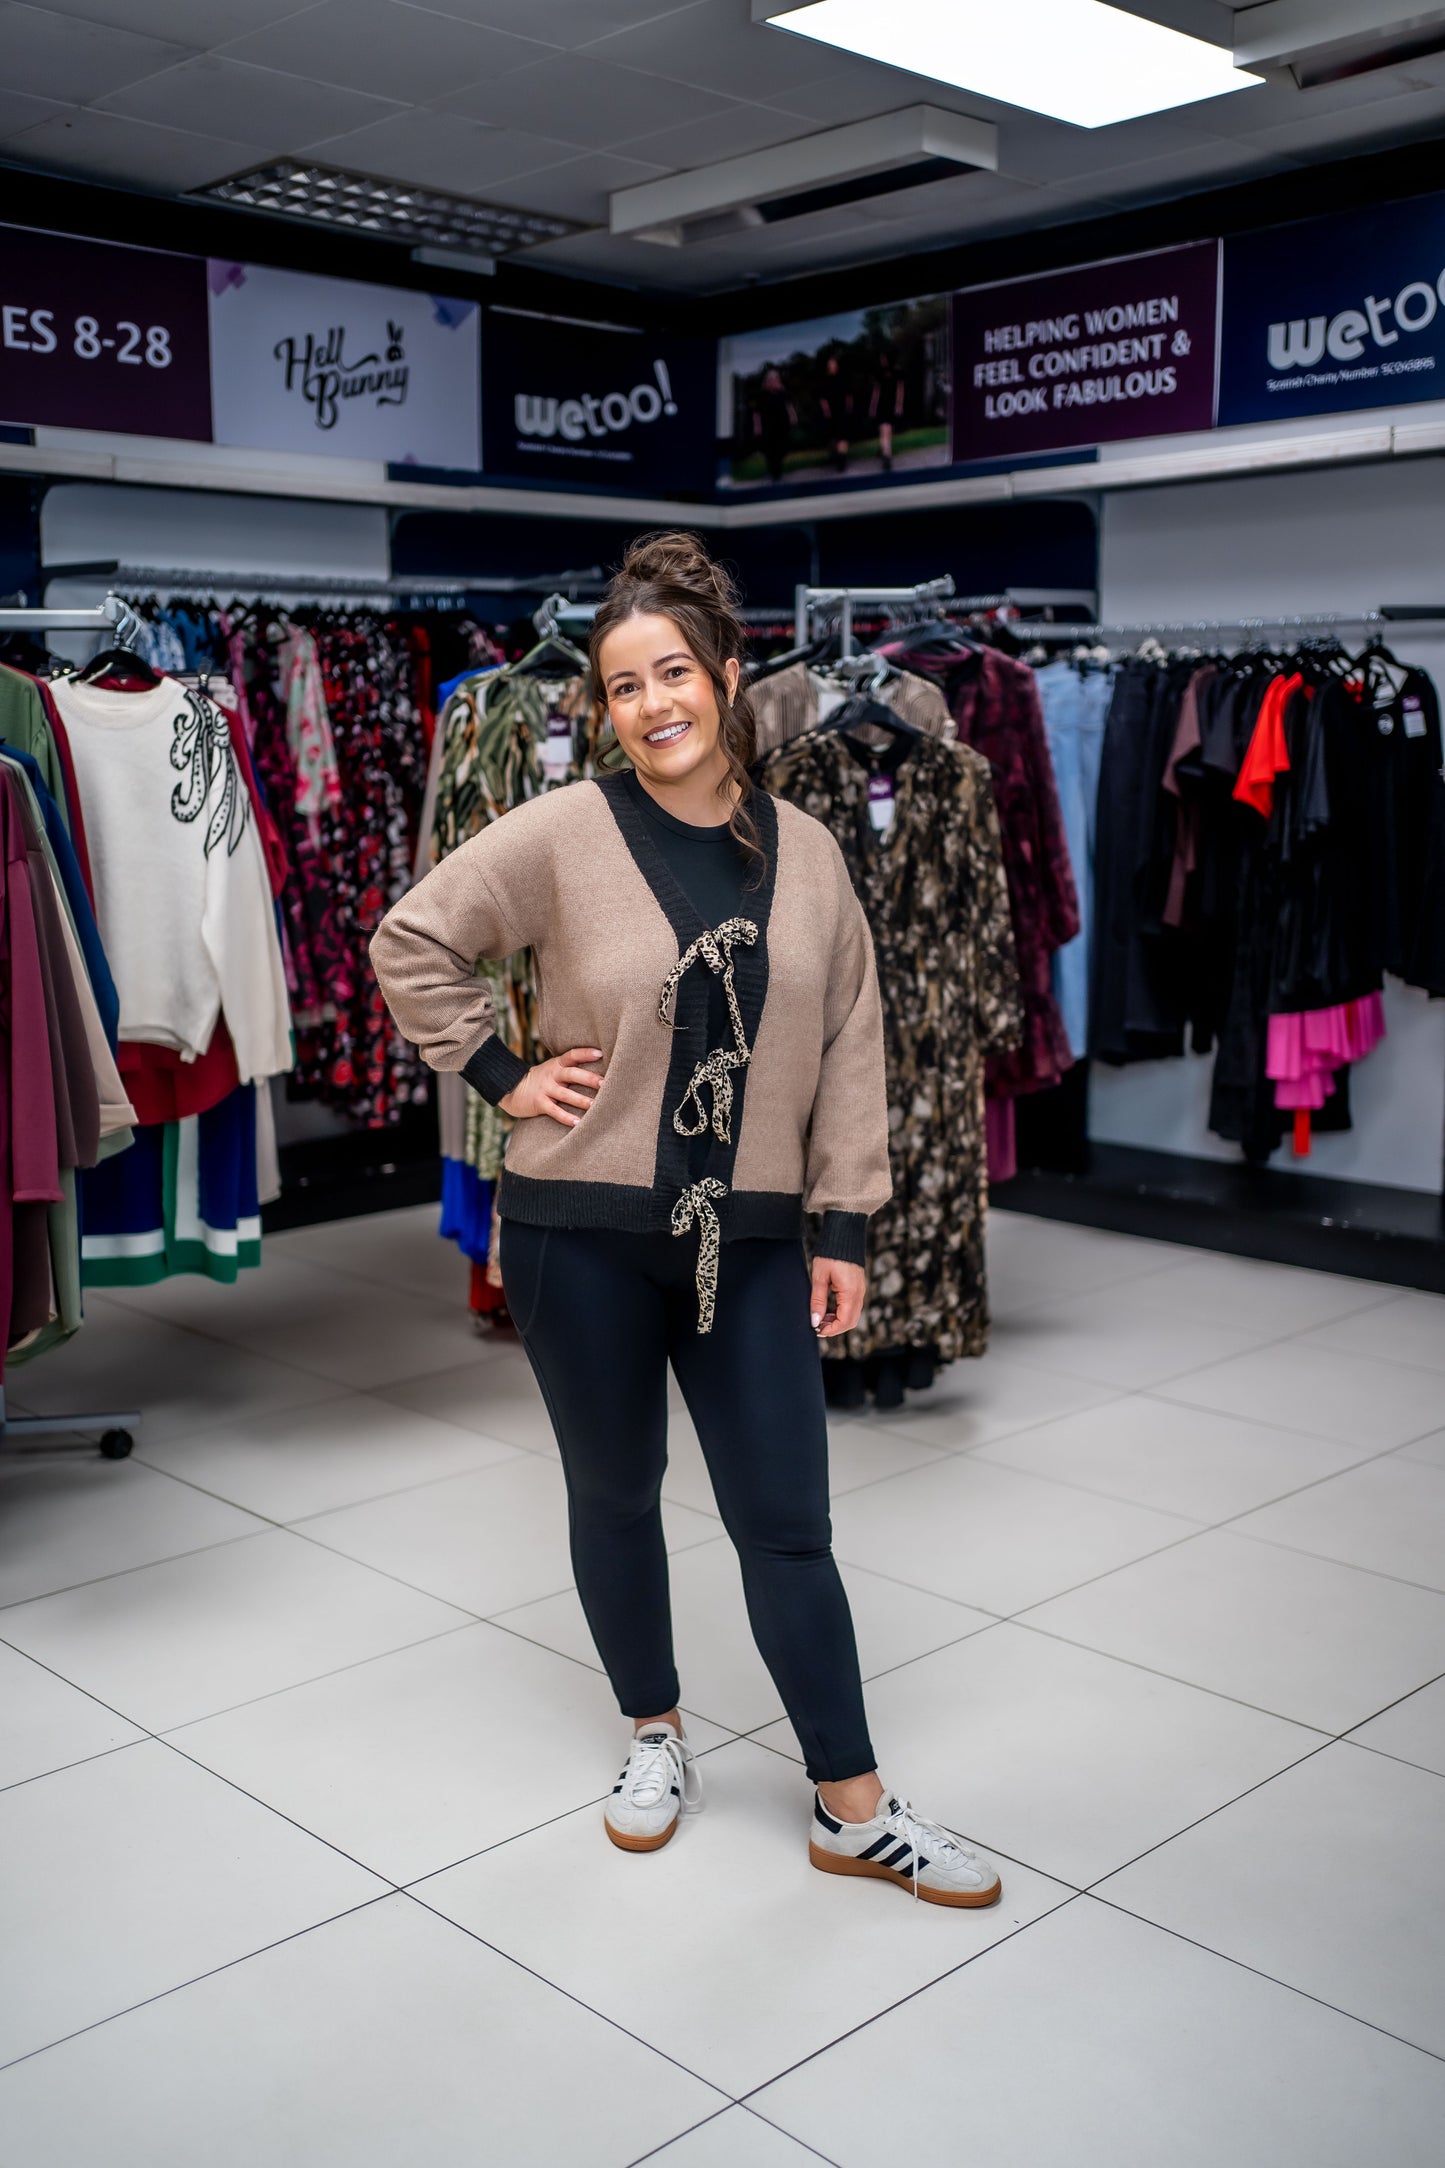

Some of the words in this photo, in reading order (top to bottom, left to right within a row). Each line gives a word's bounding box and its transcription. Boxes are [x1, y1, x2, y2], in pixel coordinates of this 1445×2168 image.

[2, 305, 58, 353] ES
[73, 315, 173, 369] 8-28
[984, 313, 1080, 354] HELPING
[1084, 295, 1180, 336] WOMEN
[1267, 266, 1445, 371] weto
[273, 325, 381, 392] Hell
[973, 358, 1026, 388] FEEL
[1028, 332, 1168, 380] CONFIDENT
[1171, 328, 1192, 357] &
[302, 366, 409, 430] Bunny
[514, 359, 678, 441] wetoo!
[985, 387, 1048, 420] LOOK
[1052, 366, 1178, 409] FABULOUS
